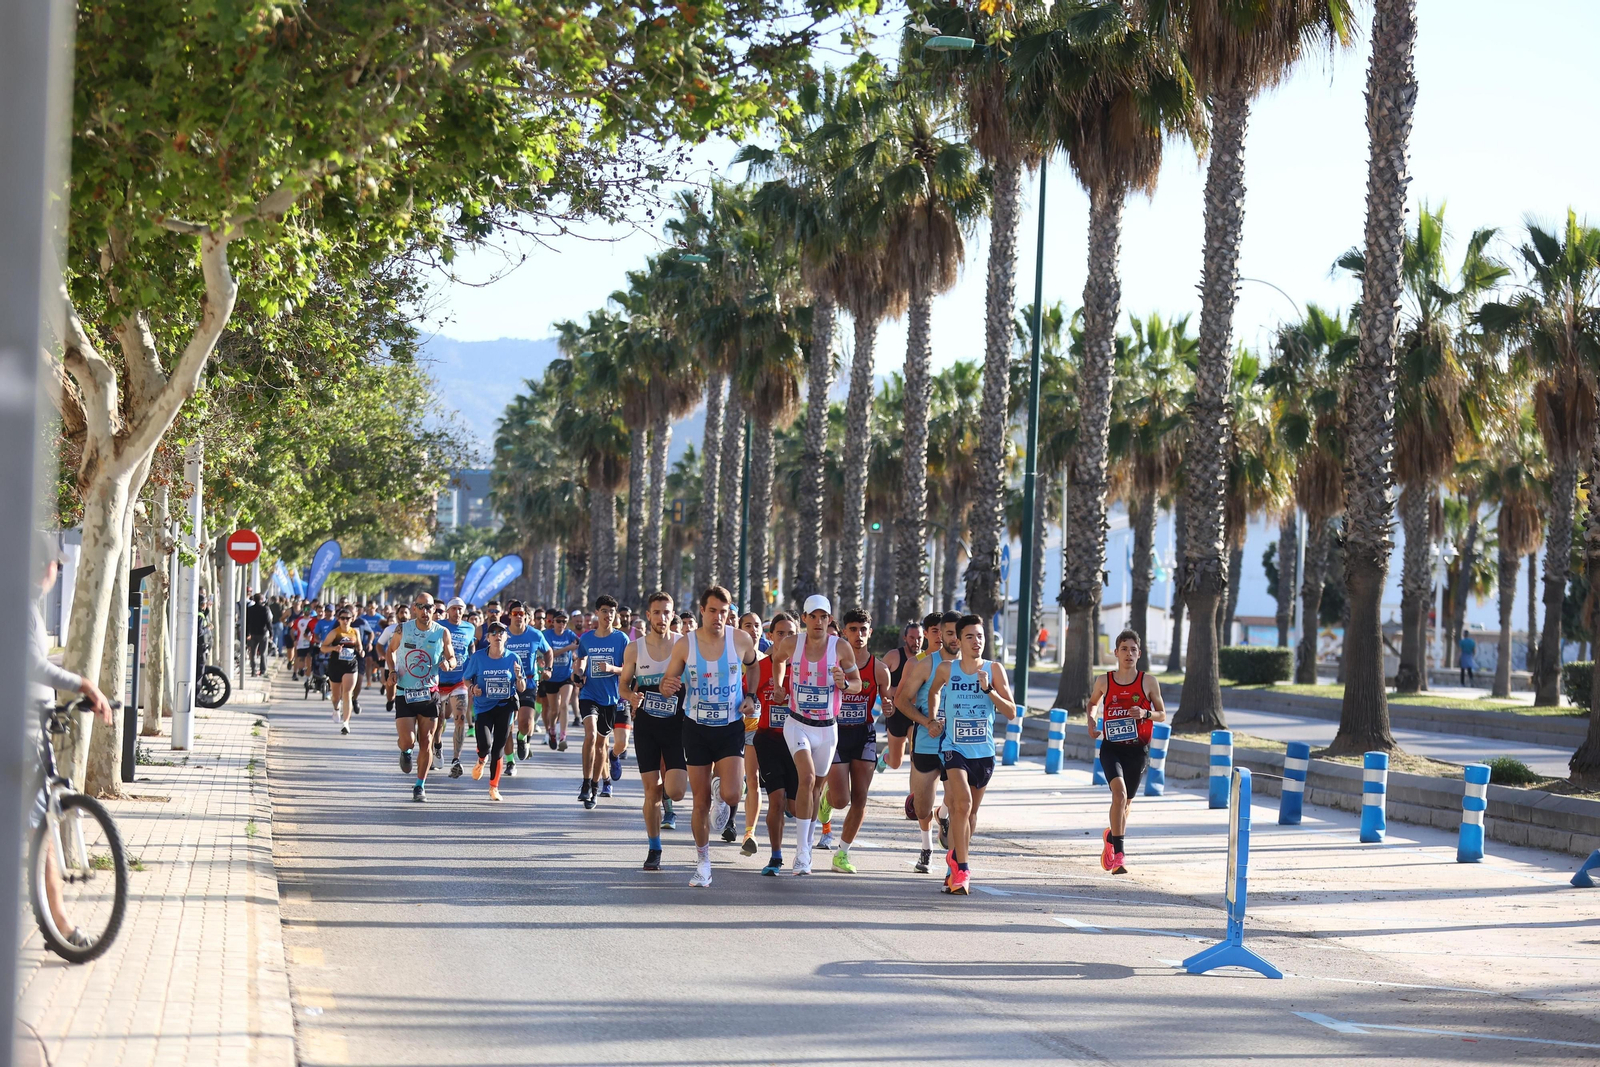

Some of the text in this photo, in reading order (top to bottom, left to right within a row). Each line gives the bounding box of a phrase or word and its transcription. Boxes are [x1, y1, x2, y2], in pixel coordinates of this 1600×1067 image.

[416, 563, 450, 572] mayoral
[478, 563, 515, 599] mayoral
[483, 668, 510, 676] mayoral
[951, 680, 981, 694] nerj
[806, 694, 820, 702] 25
[648, 701, 673, 711] 1992
[706, 711, 720, 719] 26
[840, 710, 864, 718] 1634
[957, 727, 985, 736] 2156
[1109, 725, 1134, 735] 2149
